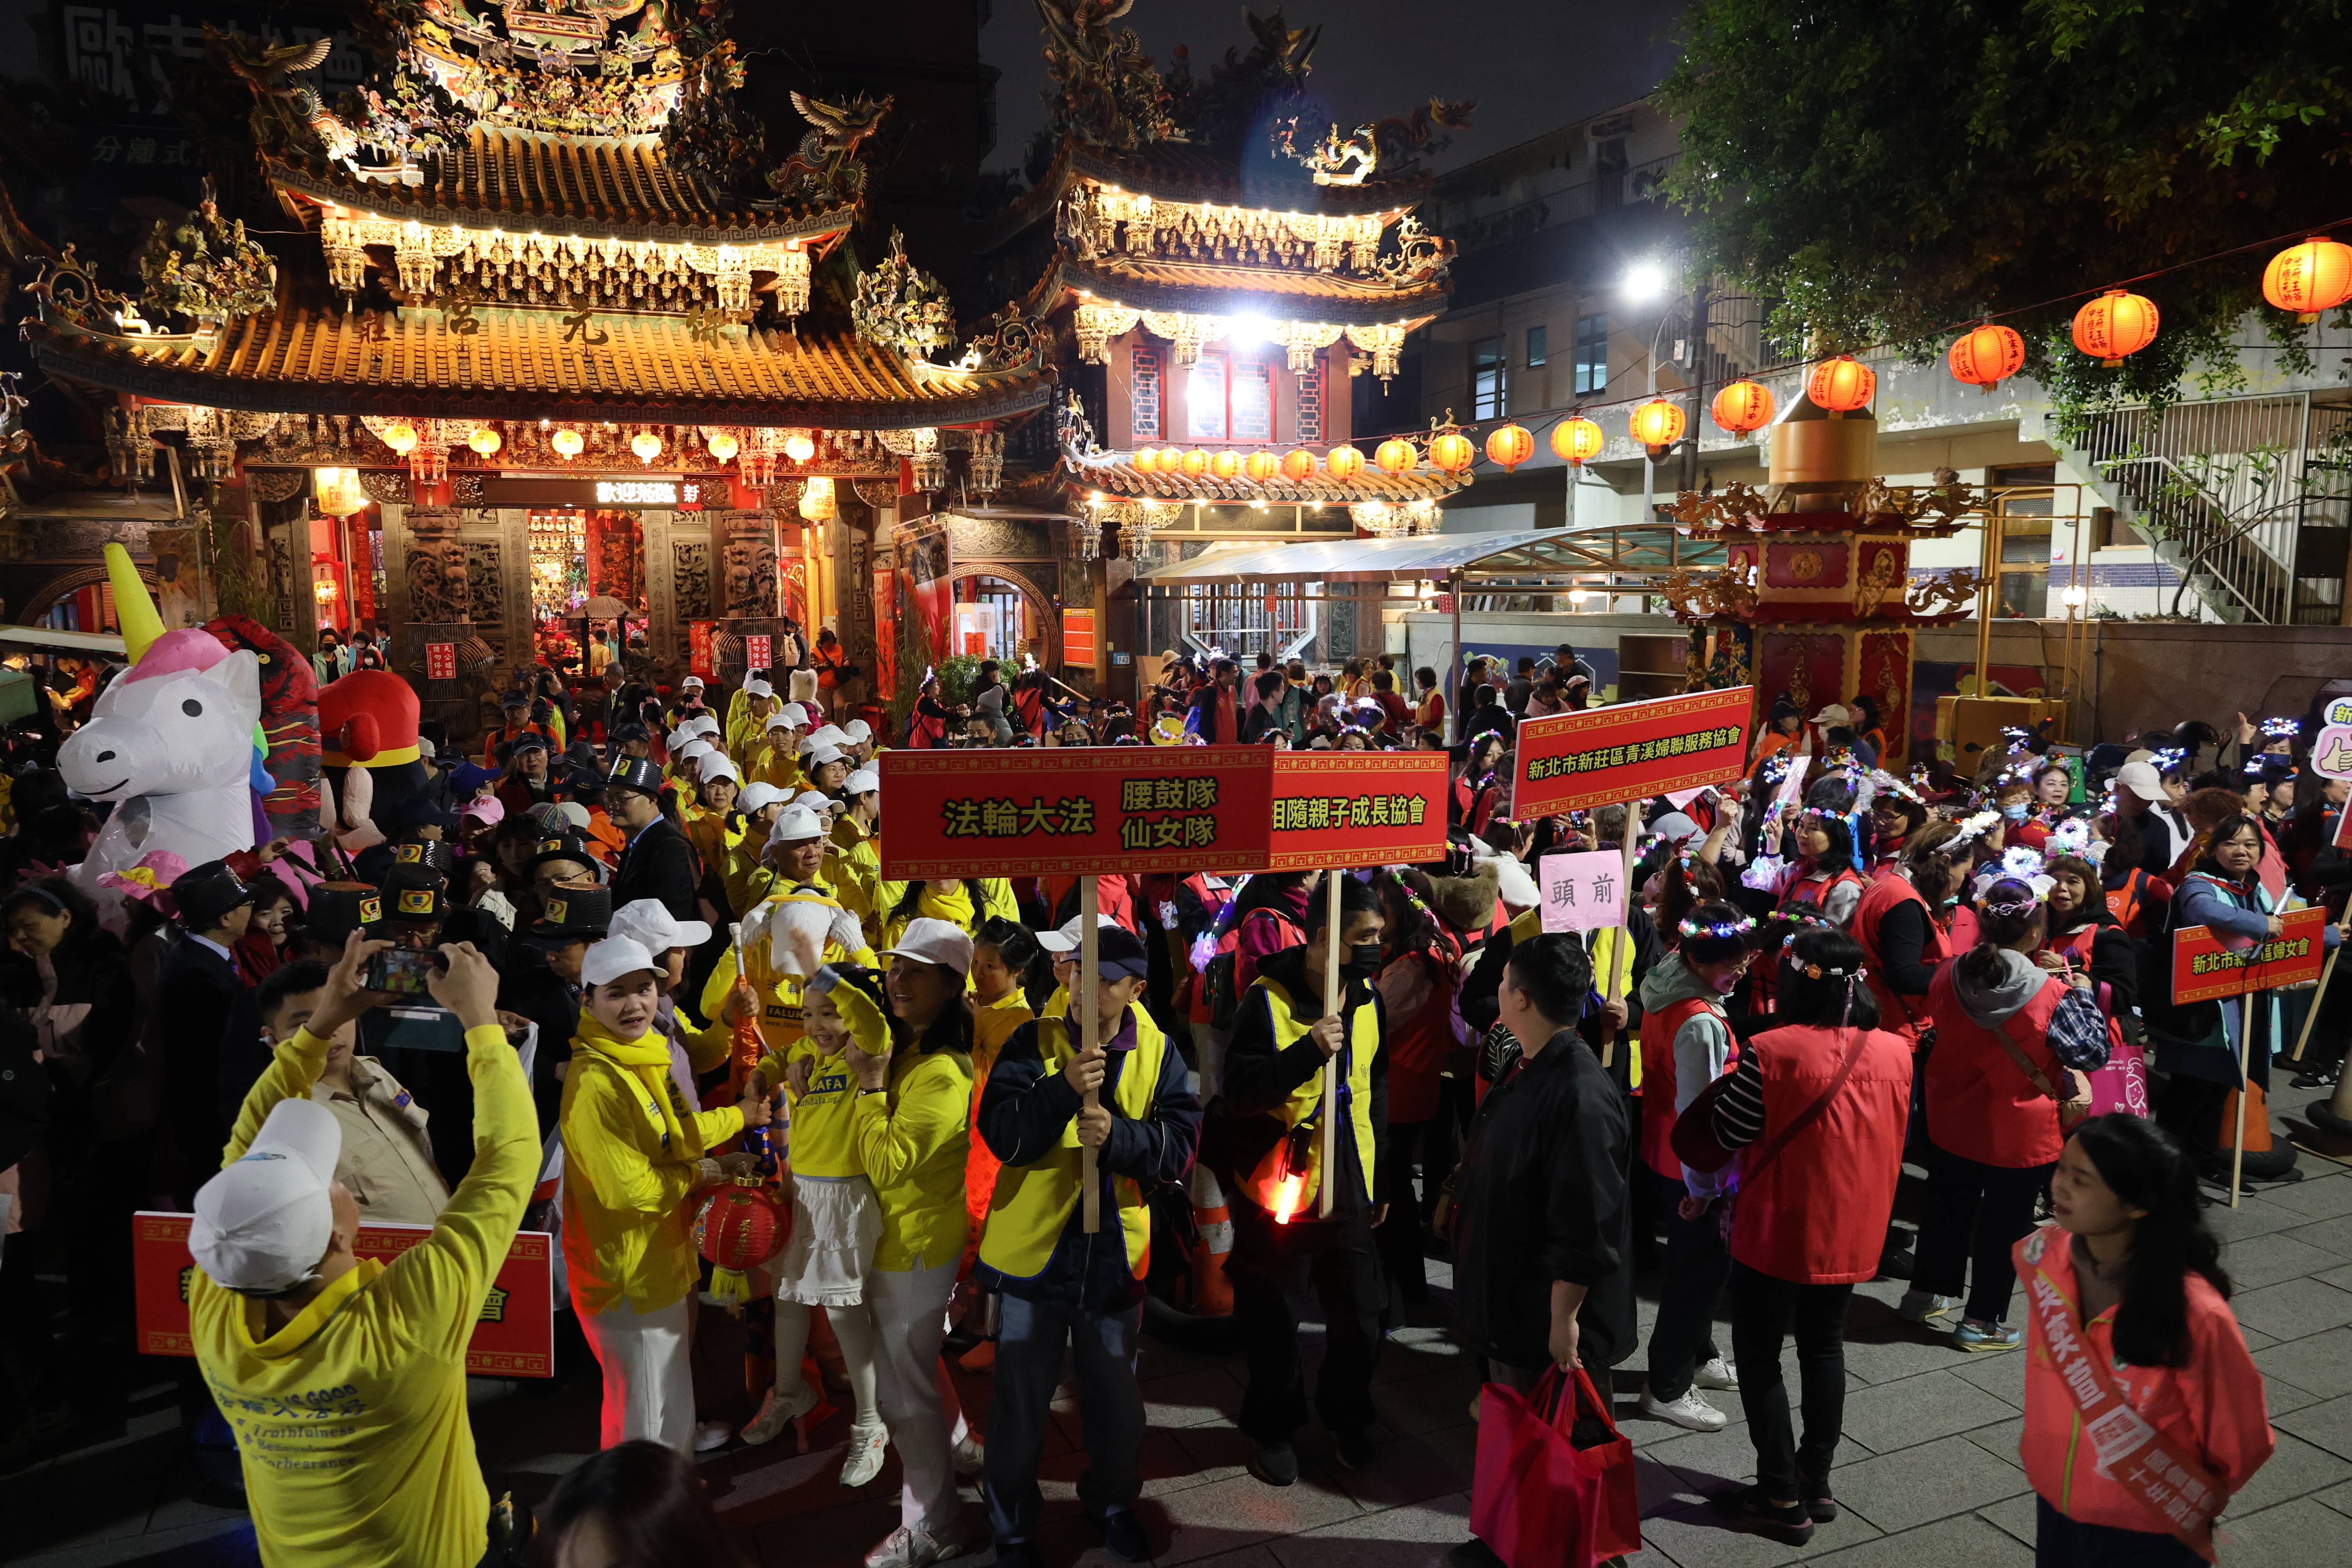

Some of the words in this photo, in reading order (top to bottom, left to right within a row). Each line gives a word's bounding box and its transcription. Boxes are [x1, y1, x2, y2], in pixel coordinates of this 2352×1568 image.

[92, 135, 205, 166] 分離式
[1746, 386, 1760, 421] 合家平安
[1853, 369, 1870, 406] 合家平安
[1663, 407, 1677, 441] 合家平安
[433, 646, 443, 677] 請勿停車
[752, 637, 760, 667] 請勿停車
[1528, 726, 1741, 780] 新北市新莊區青溪婦聯服務協會
[1122, 778, 1217, 811] 腰鼓隊
[1272, 794, 1426, 829] 相隨親子成長協會
[944, 797, 1094, 837] 法輪大法
[1121, 816, 1216, 849] 仙女隊
[1550, 873, 1615, 908] 頭前
[769, 1008, 802, 1019] FALUN
